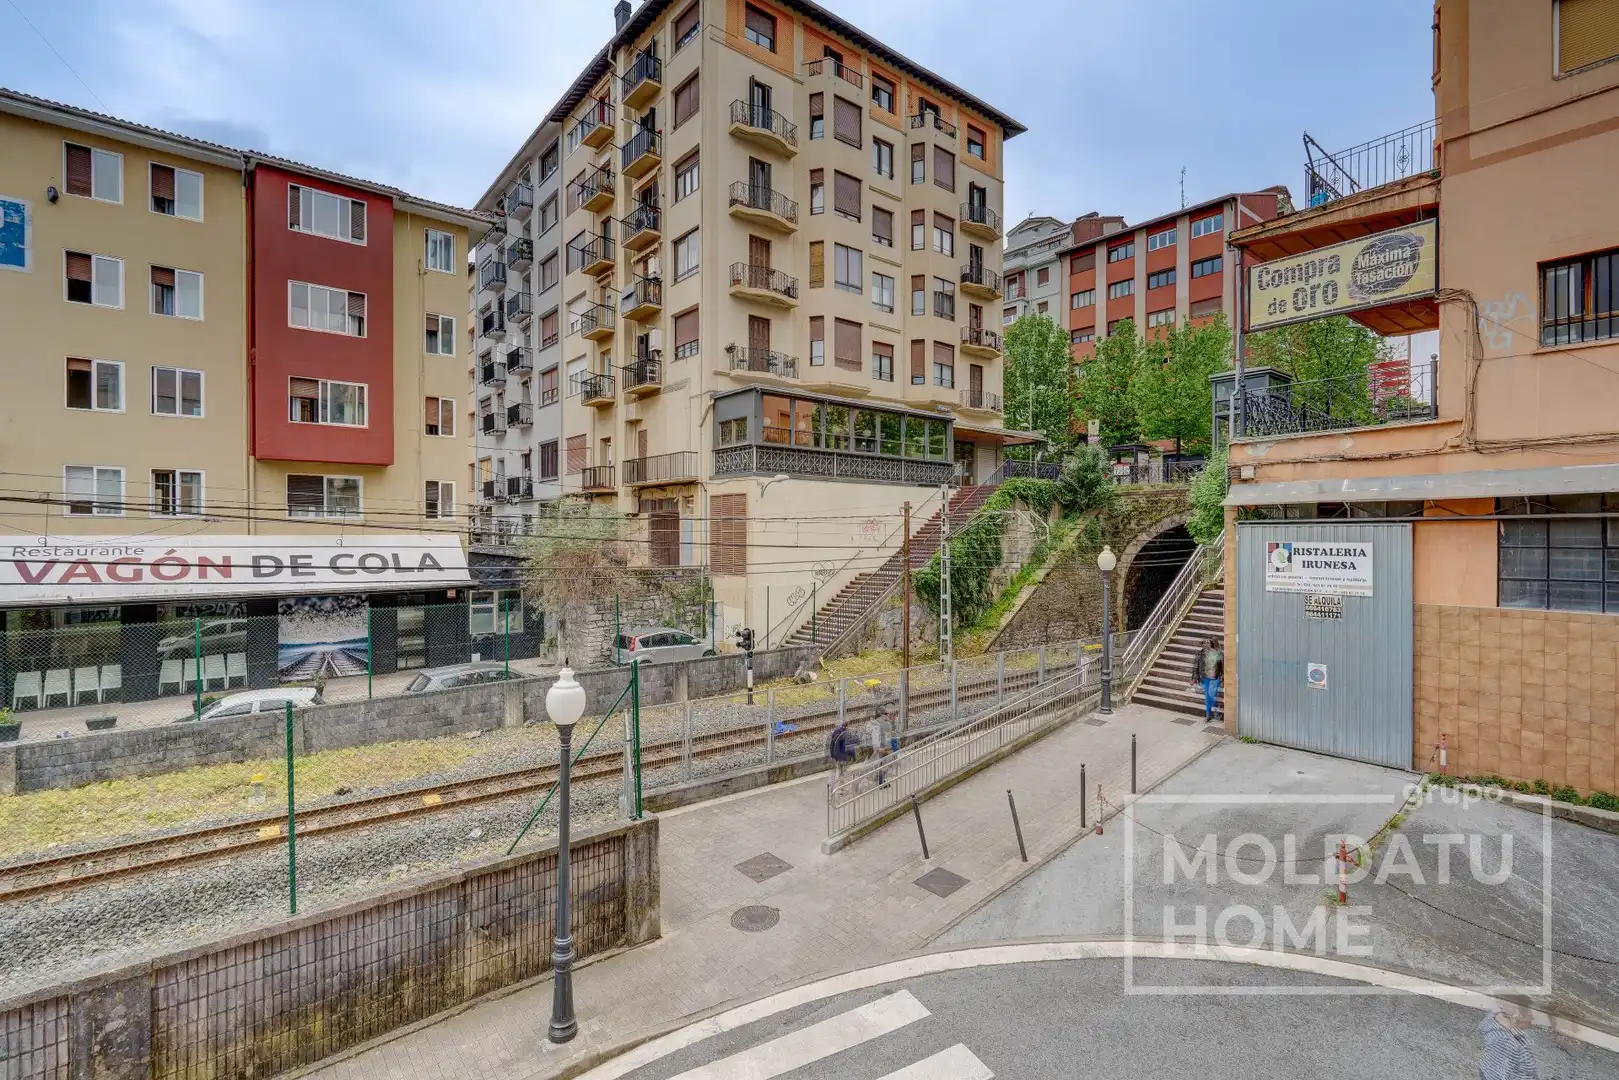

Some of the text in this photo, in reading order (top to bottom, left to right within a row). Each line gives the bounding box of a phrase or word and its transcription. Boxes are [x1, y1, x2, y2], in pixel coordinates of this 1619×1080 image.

[1257, 254, 1340, 291] Compra
[1267, 297, 1287, 316] de
[12, 546, 145, 557] Restaurante
[12, 549, 446, 584] VAGÓN DE COLA
[1302, 560, 1357, 570] IRUNESA
[1304, 595, 1313, 605] SE
